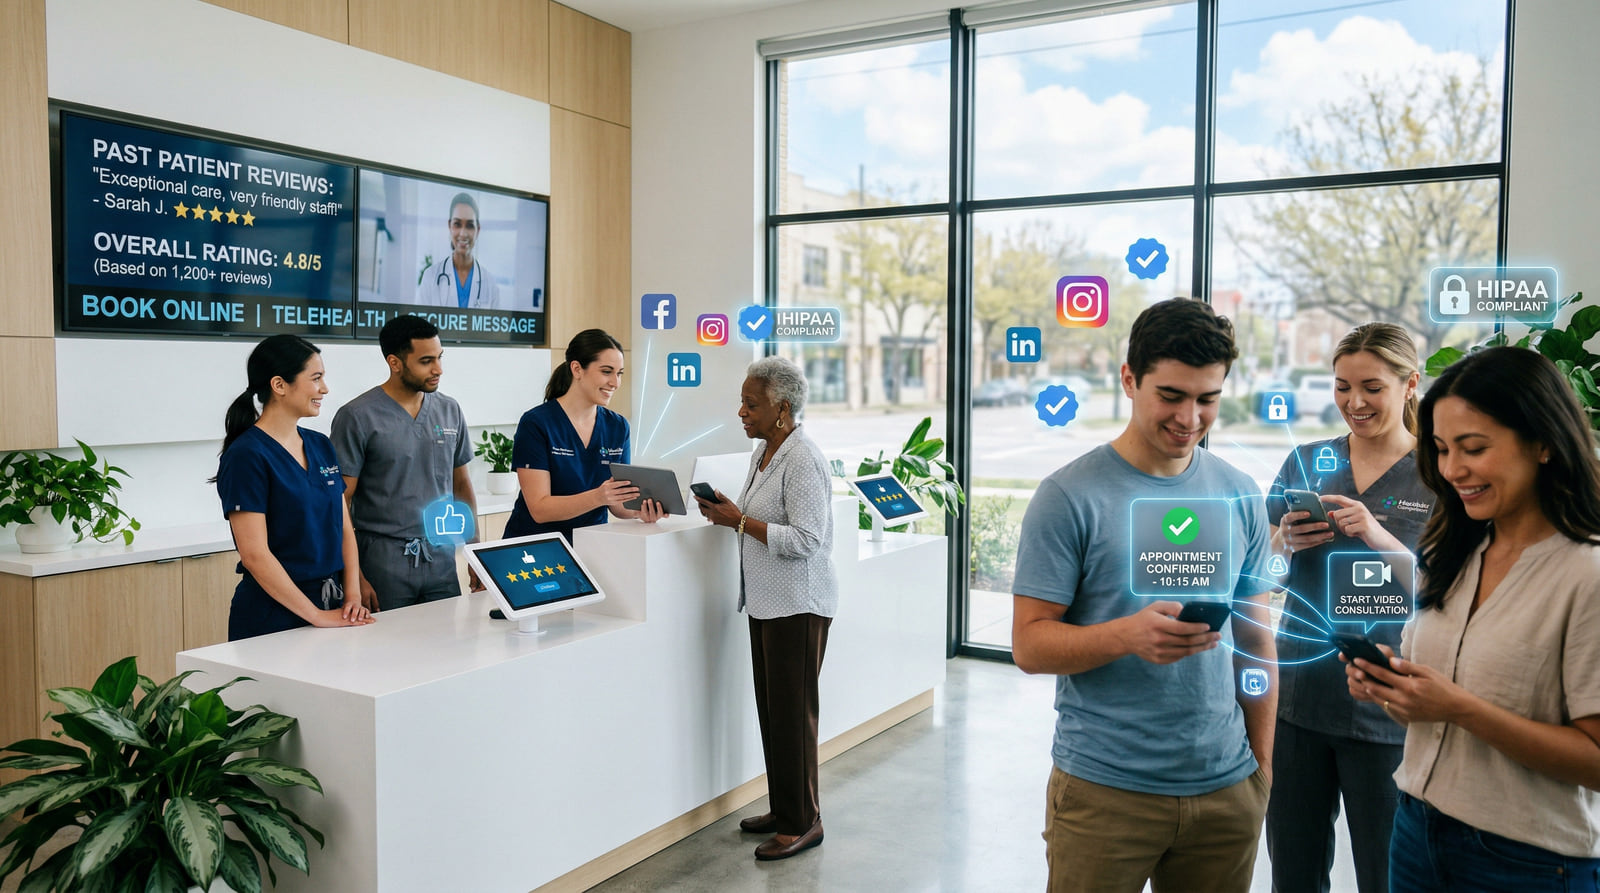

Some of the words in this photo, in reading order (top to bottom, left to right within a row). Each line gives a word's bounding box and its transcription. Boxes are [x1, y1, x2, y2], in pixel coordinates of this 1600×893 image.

[93, 138, 152, 166] PAST
[158, 149, 242, 181] PATIENT
[247, 164, 334, 195] REVIEWS:
[92, 166, 187, 195] "Exceptional
[191, 185, 226, 203] care,
[229, 190, 258, 208] very
[261, 192, 307, 215] friendly
[309, 201, 343, 217] staff!"
[104, 192, 151, 213] Sarah
[155, 199, 168, 215] J.
[93, 231, 197, 260] OVERALL
[202, 242, 278, 268] RATING:
[283, 251, 322, 272] 4.8/5
[93, 258, 146, 277] (Based
[149, 266, 167, 278] on
[171, 264, 217, 281] 1,200+
[220, 270, 272, 289] reviews)
[82, 294, 157, 319] BOOK
[162, 299, 245, 323] ONLINE
[408, 311, 468, 332] CURE
[471, 316, 537, 334] MESSAGE
